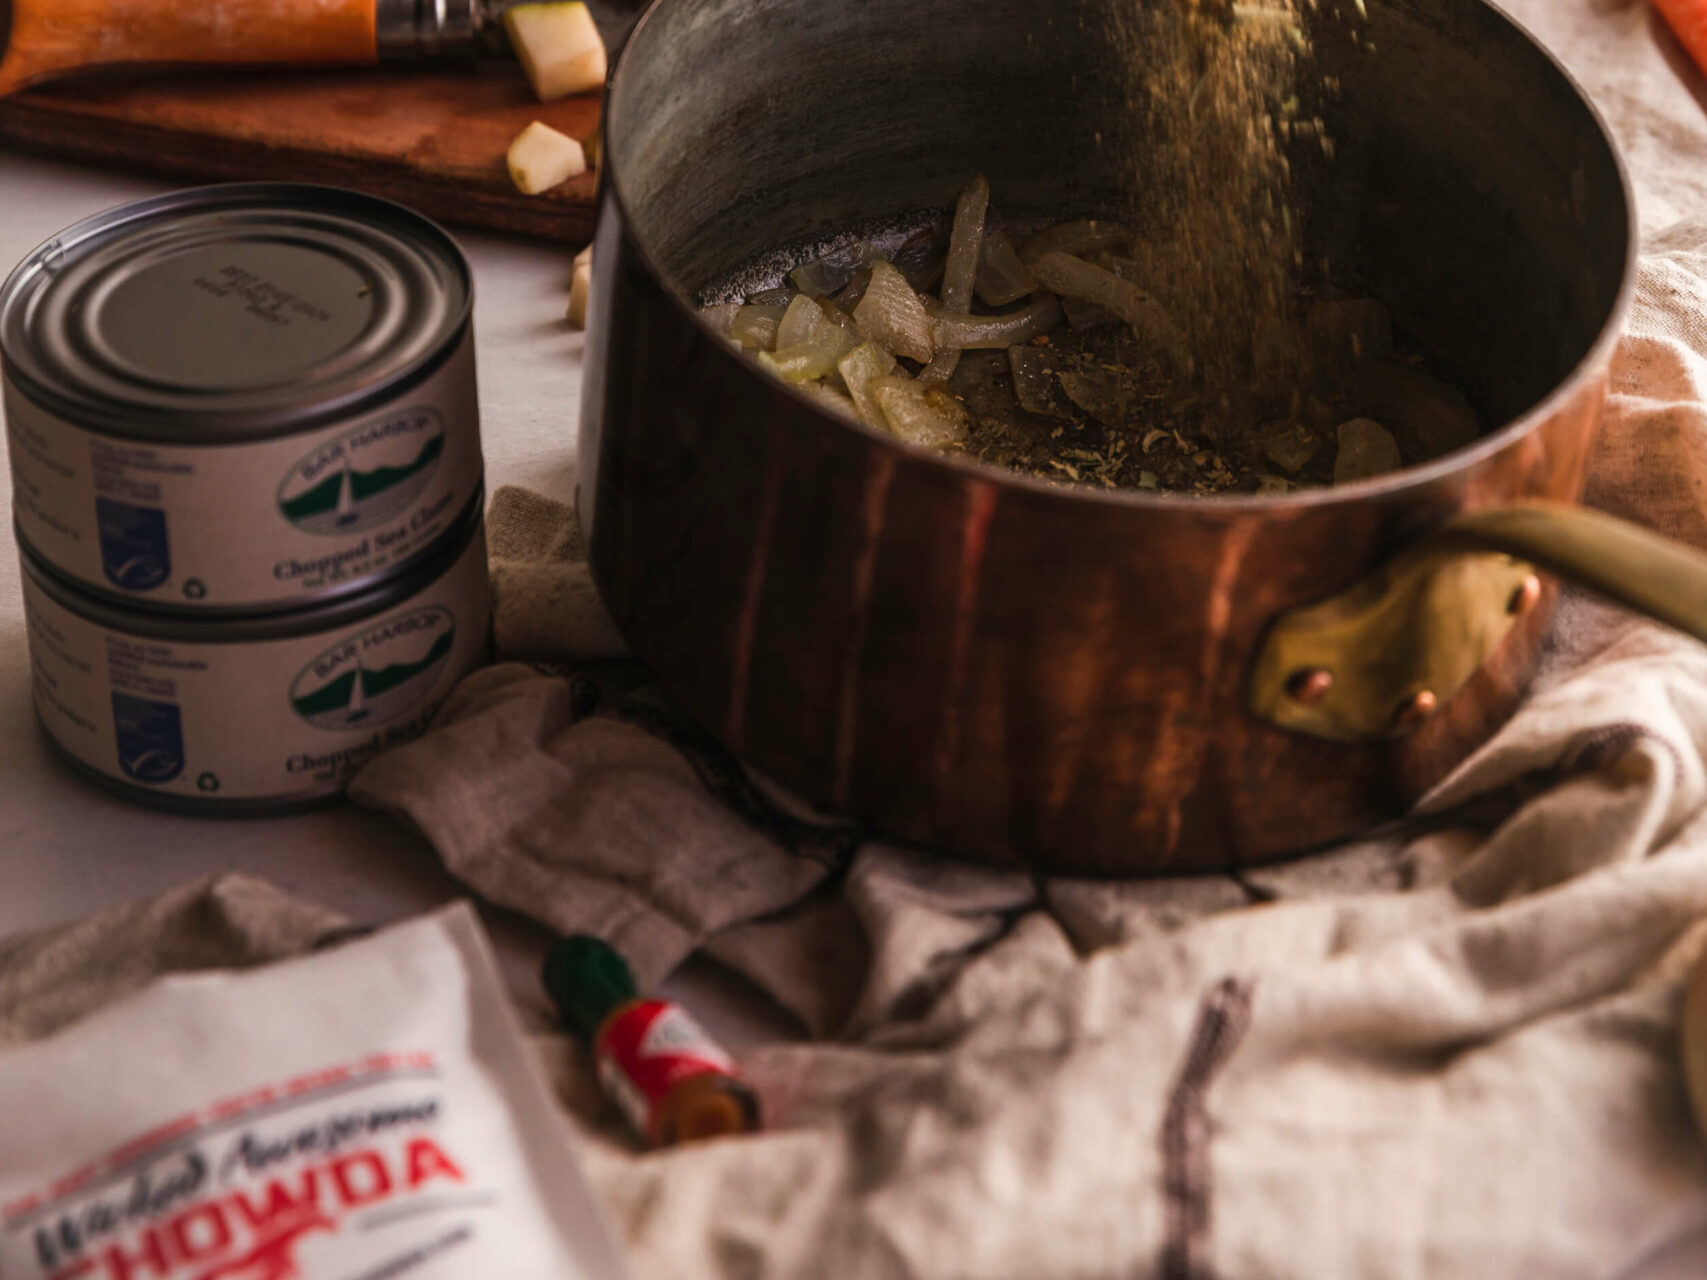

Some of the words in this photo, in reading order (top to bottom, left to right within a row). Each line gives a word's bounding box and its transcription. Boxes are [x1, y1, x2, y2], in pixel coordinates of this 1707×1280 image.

[272, 538, 370, 581] Chopped
[313, 644, 357, 679] BAR
[362, 613, 442, 649] HARBOR
[46, 1136, 467, 1280] HOWDA
